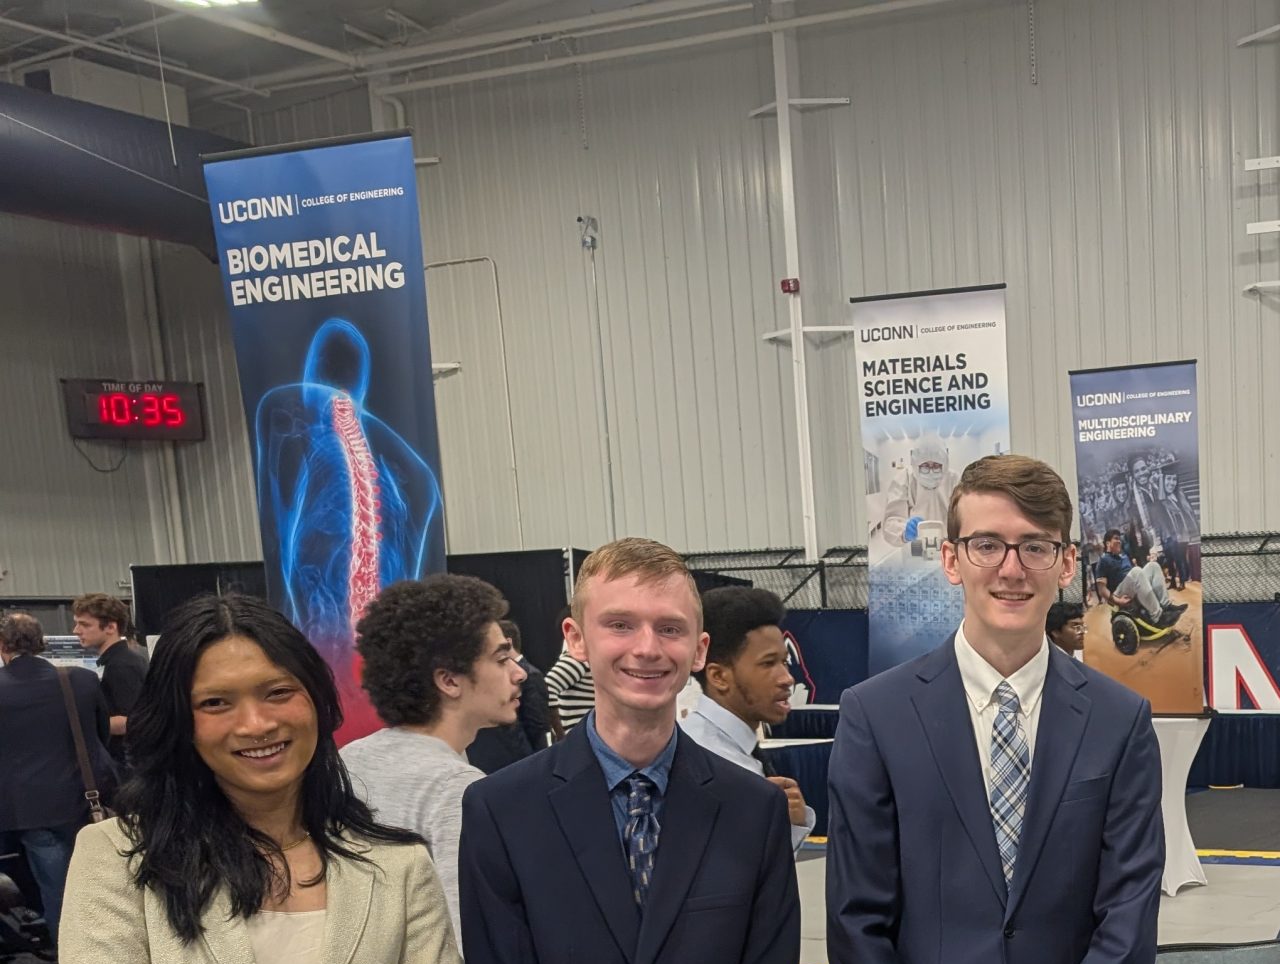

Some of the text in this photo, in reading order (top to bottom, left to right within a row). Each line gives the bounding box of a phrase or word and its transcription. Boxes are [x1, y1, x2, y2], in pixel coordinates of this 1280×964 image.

[219, 187, 404, 224] UCONN COLLEGE OF ENGINEERING
[227, 232, 386, 275] BIOMEDICAL
[231, 262, 405, 306] ENGINEERING
[861, 325, 914, 342] UCONN
[920, 326, 946, 334] COLLEGE
[957, 322, 996, 330] ENGINEERING
[863, 353, 967, 376] MATERIALS
[102, 383, 163, 392] TIME OF DAY
[864, 372, 988, 397] SCIENCE AND
[99, 393, 184, 426] 10:35
[866, 393, 991, 417] ENGINEERING
[1077, 392, 1122, 407] UCONN
[1126, 392, 1147, 400] COLLEGE
[1078, 412, 1192, 430] MULTIDISCIPLINARY
[1079, 427, 1156, 442] ENGINEERING
